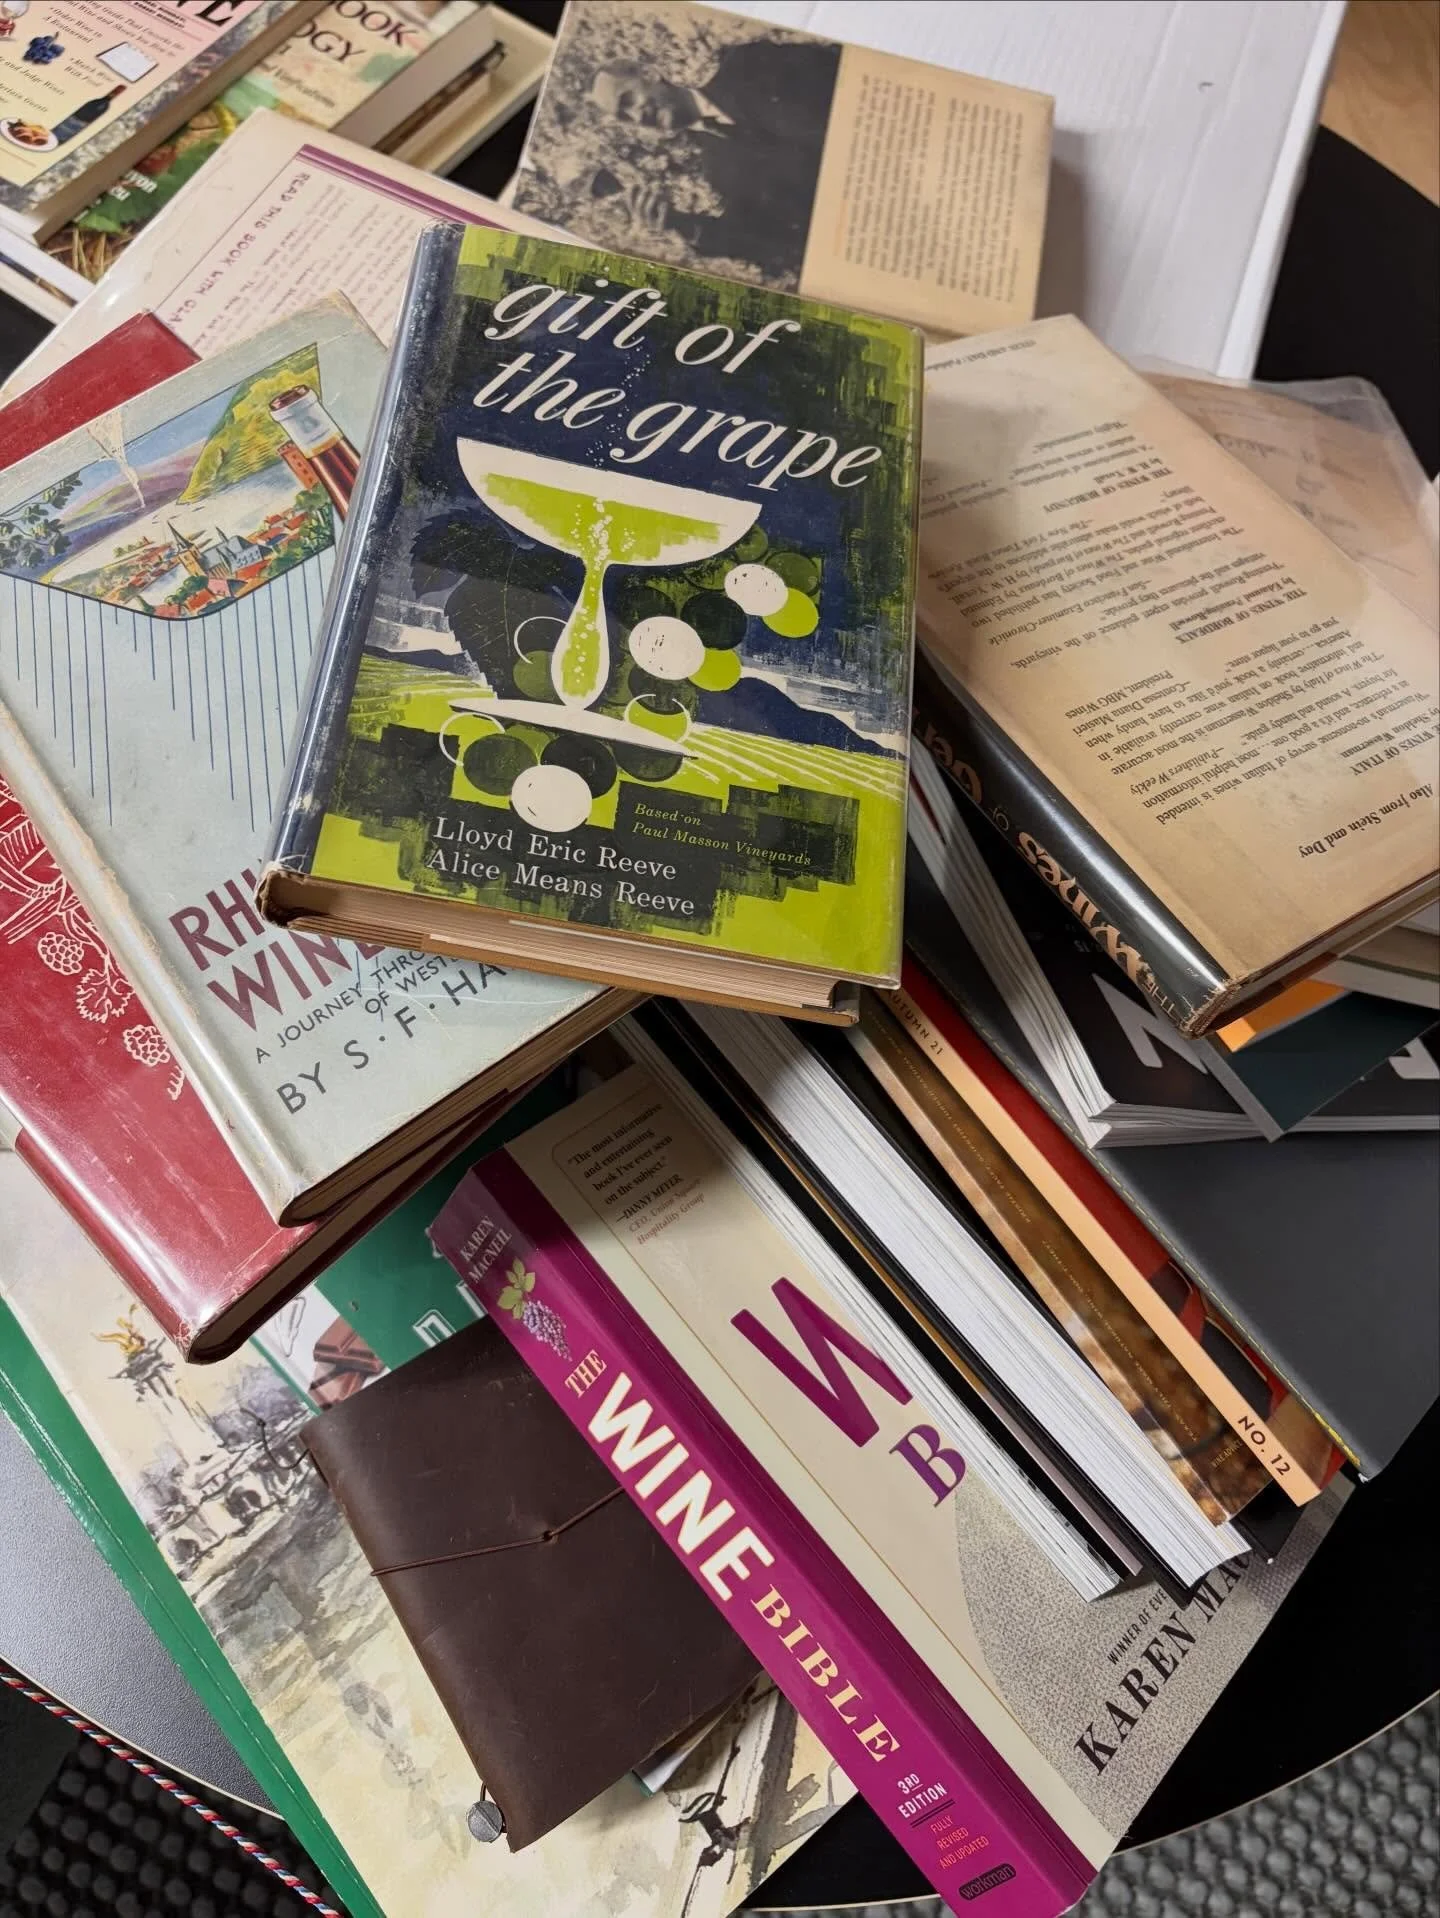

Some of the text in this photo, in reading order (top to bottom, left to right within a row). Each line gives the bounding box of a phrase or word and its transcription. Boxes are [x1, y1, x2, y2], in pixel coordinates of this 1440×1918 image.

[195, 172, 312, 296] READ THIS BOOK WITH
[484, 279, 801, 374] gift of
[473, 351, 626, 429] the
[610, 402, 882, 492] grape
[1251, 616, 1339, 658] you go your liquor
[1351, 674, 1385, 690] buyers.
[1382, 668, 1398, 678] for
[1397, 680, 1410, 688] as
[1065, 670, 1173, 719] President, MBG Wines
[1085, 670, 1259, 748] book you'd like have handy when
[1111, 700, 1144, 716] Diana
[1112, 640, 1364, 754] and informative book Italian wine currently available
[1297, 704, 1315, 718] and
[1315, 692, 1342, 710] sound
[1332, 706, 1351, 720] and
[1349, 688, 1392, 708] reference,
[1072, 713, 1117, 736] Masieri
[1111, 660, 1363, 775] Wines of Italy by Sheldon Wasserman the most accurate
[1269, 712, 1305, 728] handy
[1288, 722, 1312, 741] good
[1318, 714, 1336, 725] it's
[1340, 713, 1428, 758] Sheldon Wasserman
[1156, 717, 1370, 825] no-nonsense survey of Italian wines is intended
[1201, 760, 1238, 782] helpful
[1350, 731, 1433, 775] WINES ITALY
[1142, 776, 1203, 808] information
[635, 803, 702, 827] Based on
[1298, 783, 1434, 857] Also from Stein and Day
[434, 817, 677, 881] Lloyd Eric Reeve
[632, 822, 812, 867] Paul Masson Vineyards
[426, 850, 695, 916] Alice Means Reeve
[364, 992, 391, 1015] OF
[254, 1046, 270, 1064] A
[277, 986, 363, 1048] JOURNEY
[930, 1041, 944, 1056] 21
[276, 1062, 327, 1115] BY
[583, 1127, 656, 1180] and entertaining
[591, 1136, 614, 1153] most
[592, 1172, 618, 1192] book
[605, 1191, 619, 1206] on
[617, 1181, 637, 1197] the
[650, 1173, 685, 1200] MEYER
[637, 1192, 706, 1245] Hospitality Group
[459, 1215, 495, 1262] KAREN
[468, 1229, 512, 1284] MACNEIL
[730, 1276, 914, 1448] W
[888, 1423, 967, 1508] B
[1237, 1415, 1291, 1477] NO. 12
[564, 1348, 901, 1763] THE WINE BIBLE
[1107, 1623, 1143, 1666] WINNER
[1138, 1608, 1151, 1626] OF
[1073, 1611, 1197, 1777] KAREN
[897, 1773, 921, 1795] 3RD
[897, 1782, 948, 1819] EDITION
[930, 1815, 953, 1834] FULLY
[936, 1827, 970, 1851] REVISED
[938, 1835, 990, 1870] AND UPDATED
[960, 1865, 1015, 1899] workman
